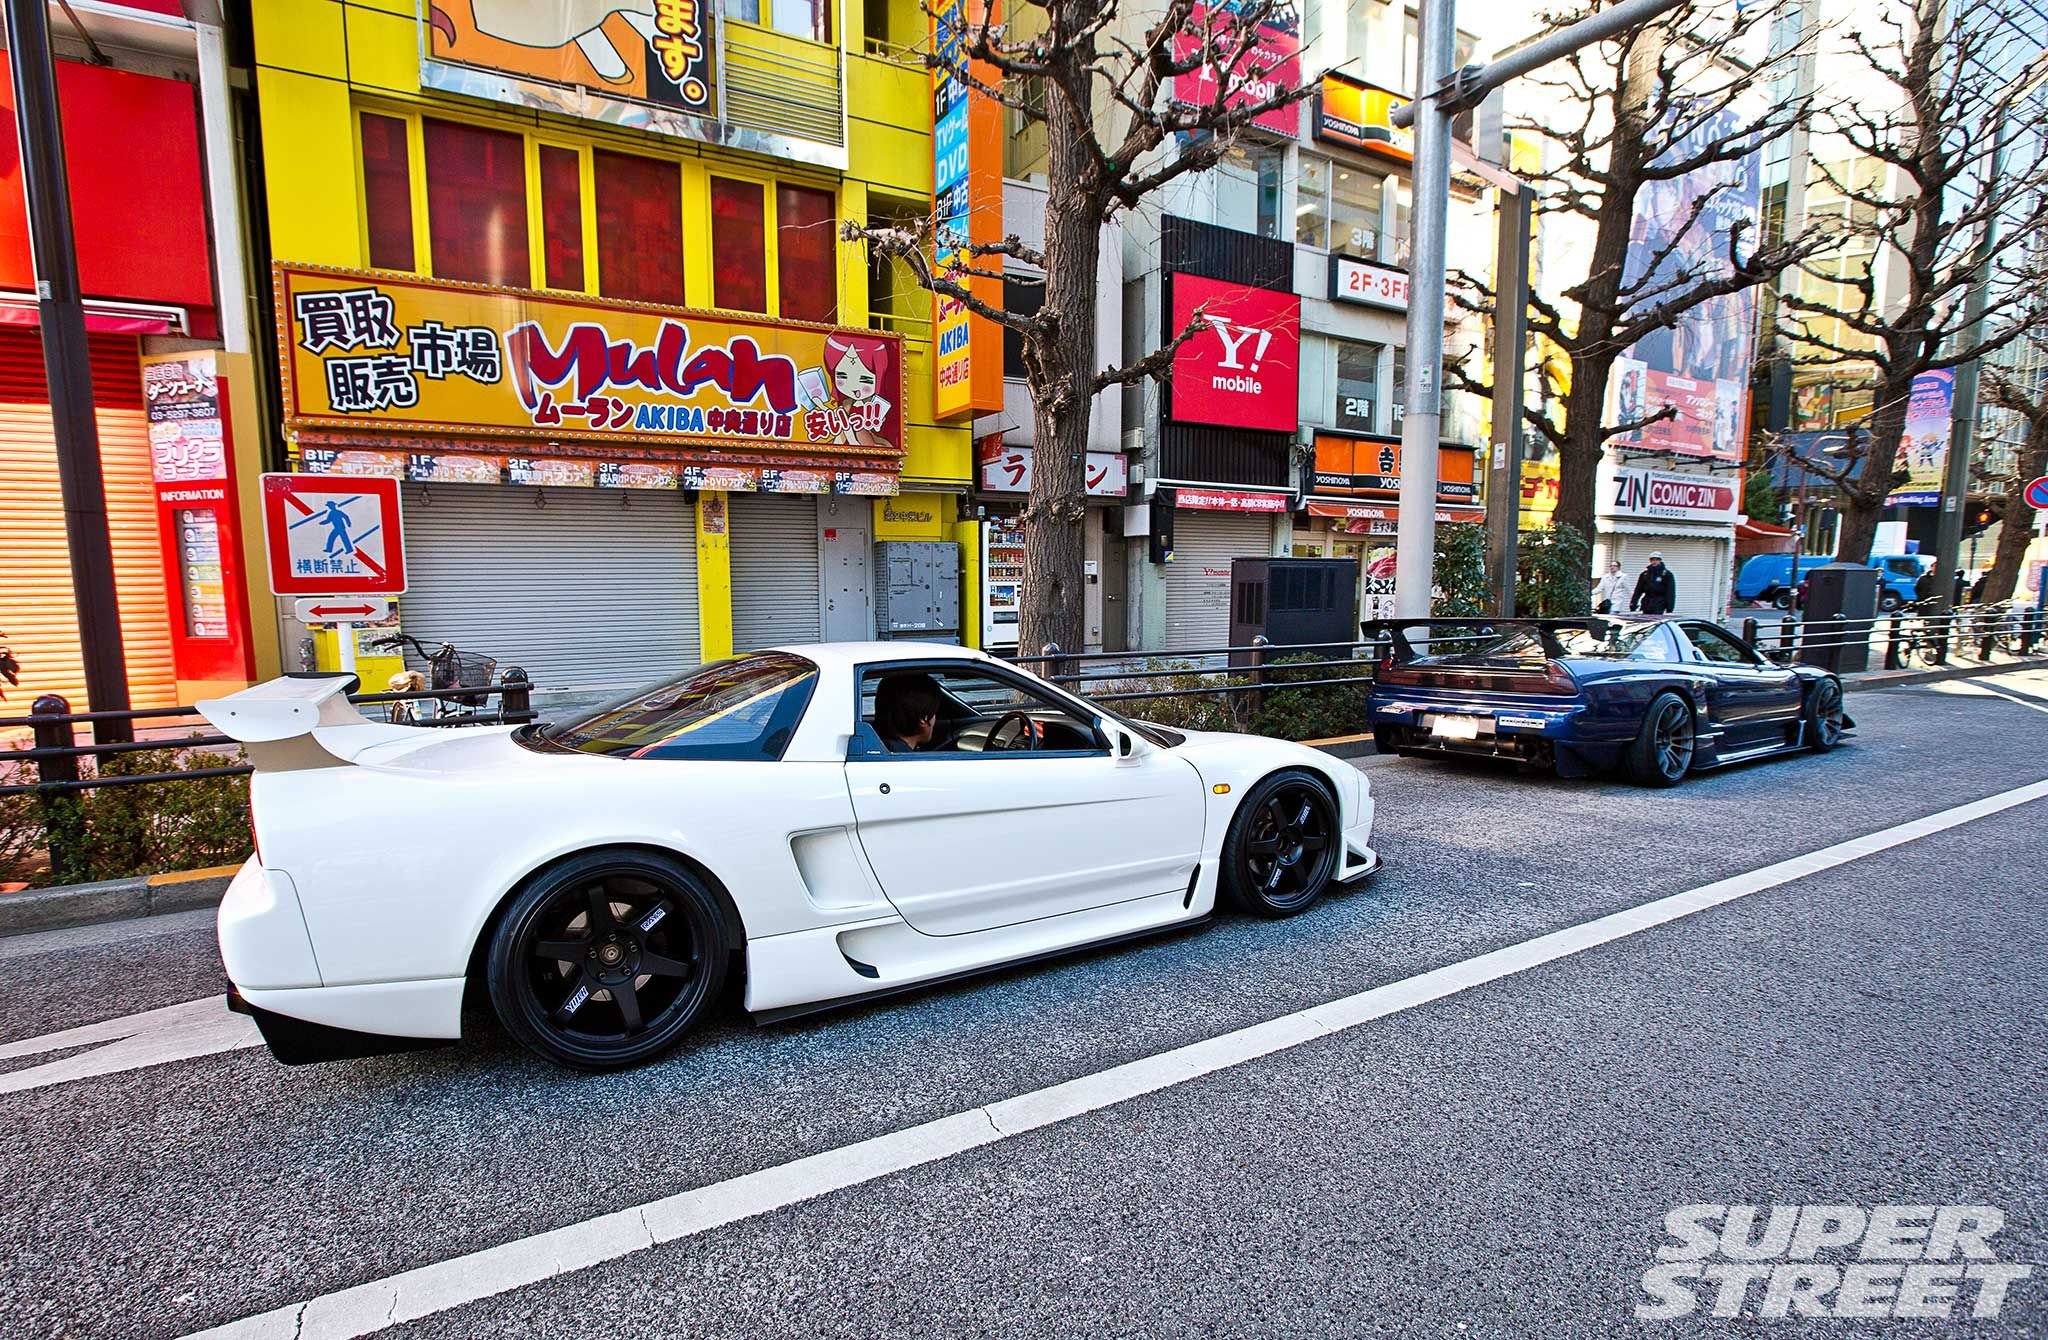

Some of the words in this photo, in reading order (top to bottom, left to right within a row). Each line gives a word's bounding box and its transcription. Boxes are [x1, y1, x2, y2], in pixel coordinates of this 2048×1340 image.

[937, 142, 968, 189] DVD
[295, 287, 402, 354] 買取
[939, 322, 969, 357] AKIBA
[1203, 314, 1272, 373] Y!
[407, 320, 501, 384] 市場
[503, 318, 800, 415] Mulan
[939, 357, 970, 389] 中央通り店
[324, 354, 418, 413] 販売
[1212, 375, 1263, 394] mobile
[533, 393, 634, 429] ムーラン
[635, 405, 705, 432] AKIBA
[707, 409, 793, 438] 中央通り店
[1345, 398, 1369, 418] 2階
[305, 449, 335, 461] B1F
[411, 455, 431, 465] 1F
[508, 458, 530, 469] 2F
[599, 462, 618, 473] 3F
[684, 466, 701, 476] 4F
[762, 469, 778, 479] 5F
[835, 472, 850, 481] 6F
[1316, 475, 1350, 486] YOSHINOYA
[1442, 484, 1472, 494] YOSHINOYA
[1613, 473, 1648, 511] ZIN
[1652, 483, 1697, 506] COMIC
[1697, 488, 1716, 508] ZIN
[161, 489, 224, 501] INFORMATION
[1347, 508, 1384, 519] YOSHINOYA
[296, 558, 360, 574] 横断禁止
